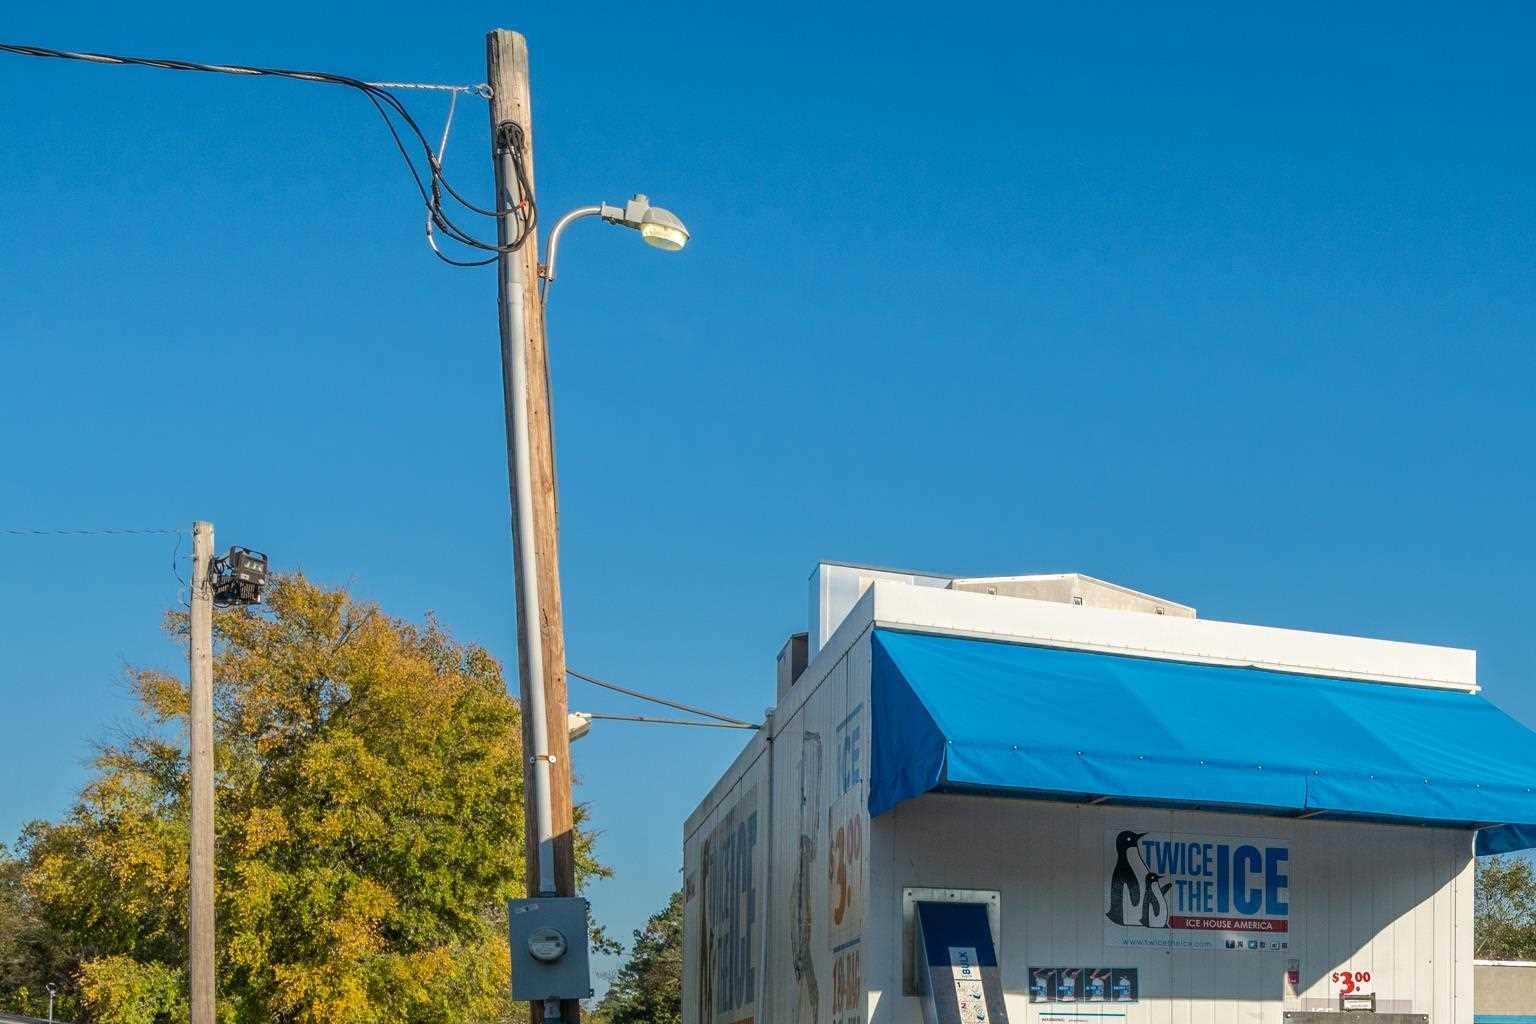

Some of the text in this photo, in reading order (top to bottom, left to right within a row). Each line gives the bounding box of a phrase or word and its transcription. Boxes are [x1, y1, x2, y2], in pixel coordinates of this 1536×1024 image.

[1142, 840, 1213, 876] TWICE
[1175, 879, 1214, 913] THE
[1216, 844, 1289, 916] ICE
[1185, 919, 1273, 930] ICE HOUSE AMERICA
[958, 951, 971, 975] BULK
